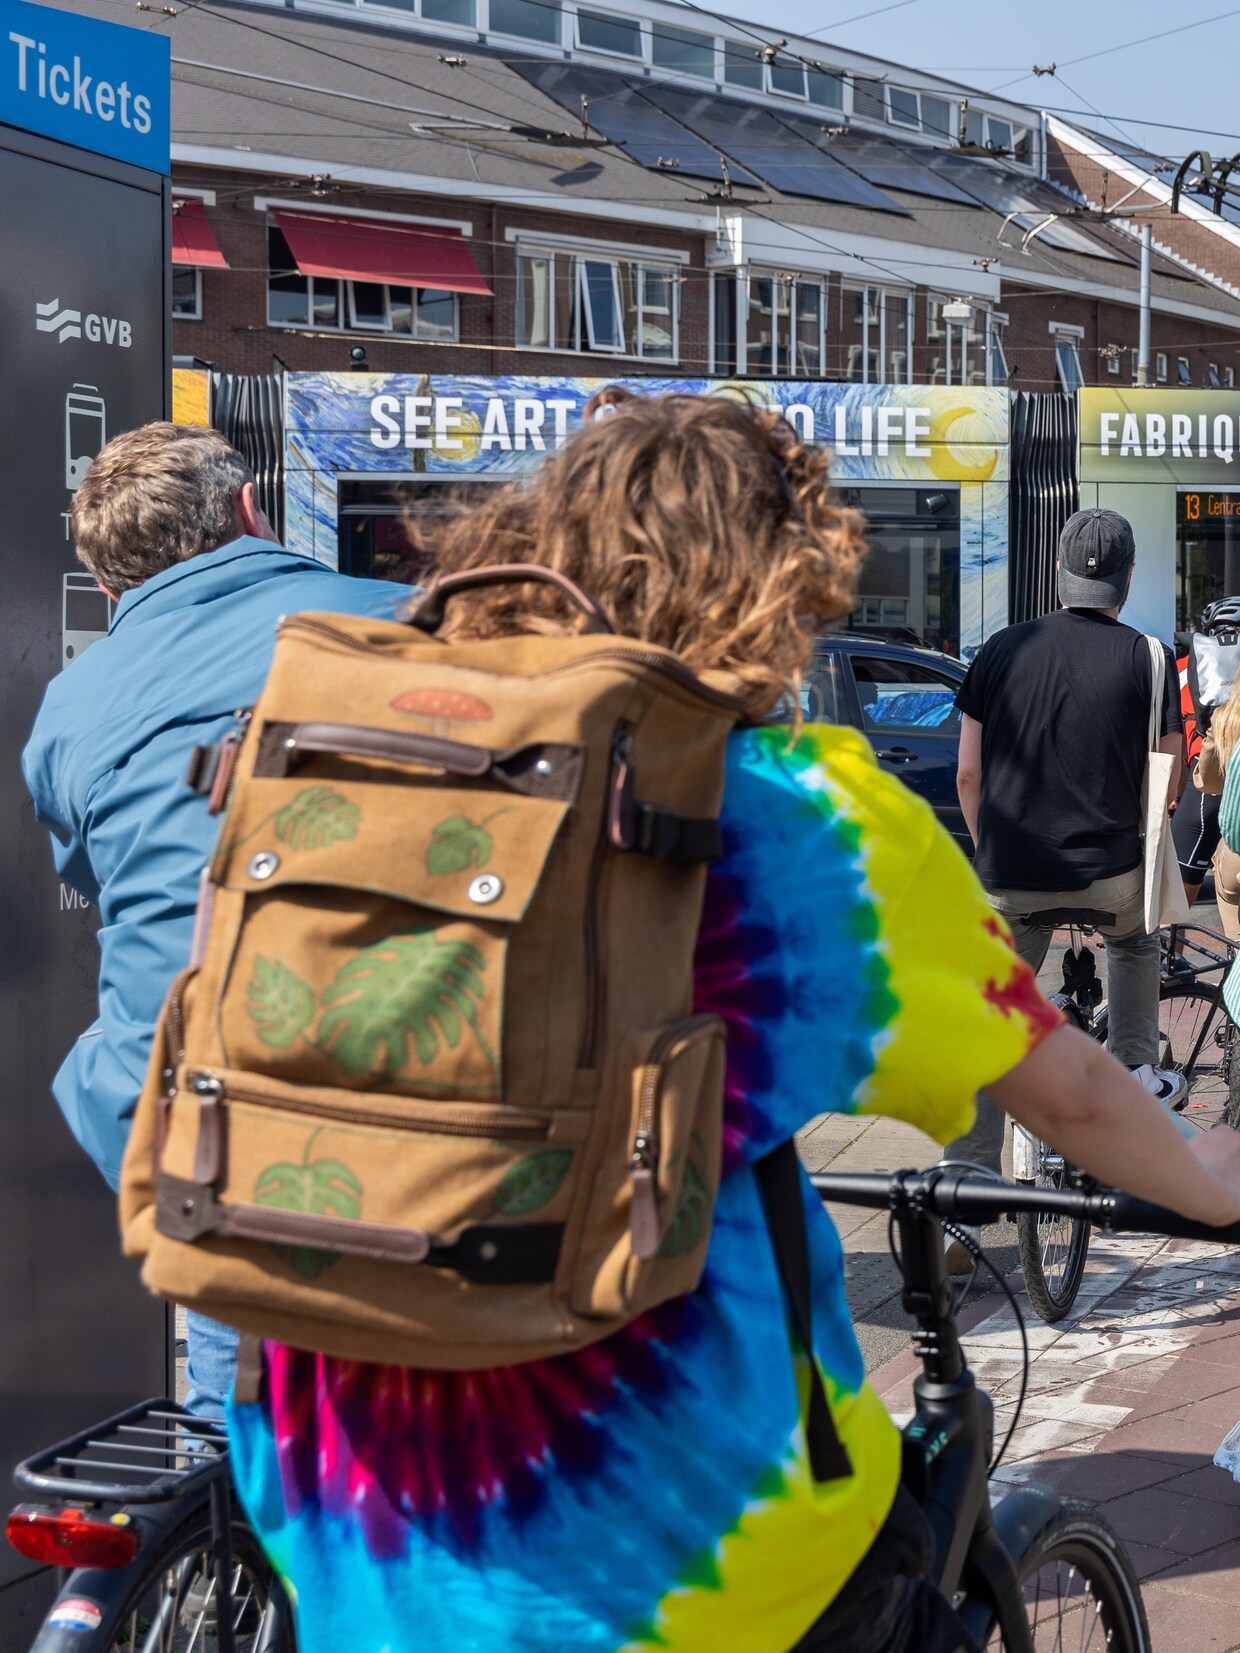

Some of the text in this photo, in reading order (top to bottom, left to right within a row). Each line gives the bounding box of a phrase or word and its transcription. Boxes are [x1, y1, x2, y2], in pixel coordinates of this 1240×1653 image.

[9, 31, 152, 134] Tickets
[85, 314, 132, 348] GVB
[370, 395, 463, 450] SEE
[481, 398, 577, 451] ART
[834, 405, 932, 457] LIFE
[1185, 494, 1200, 520] 13
